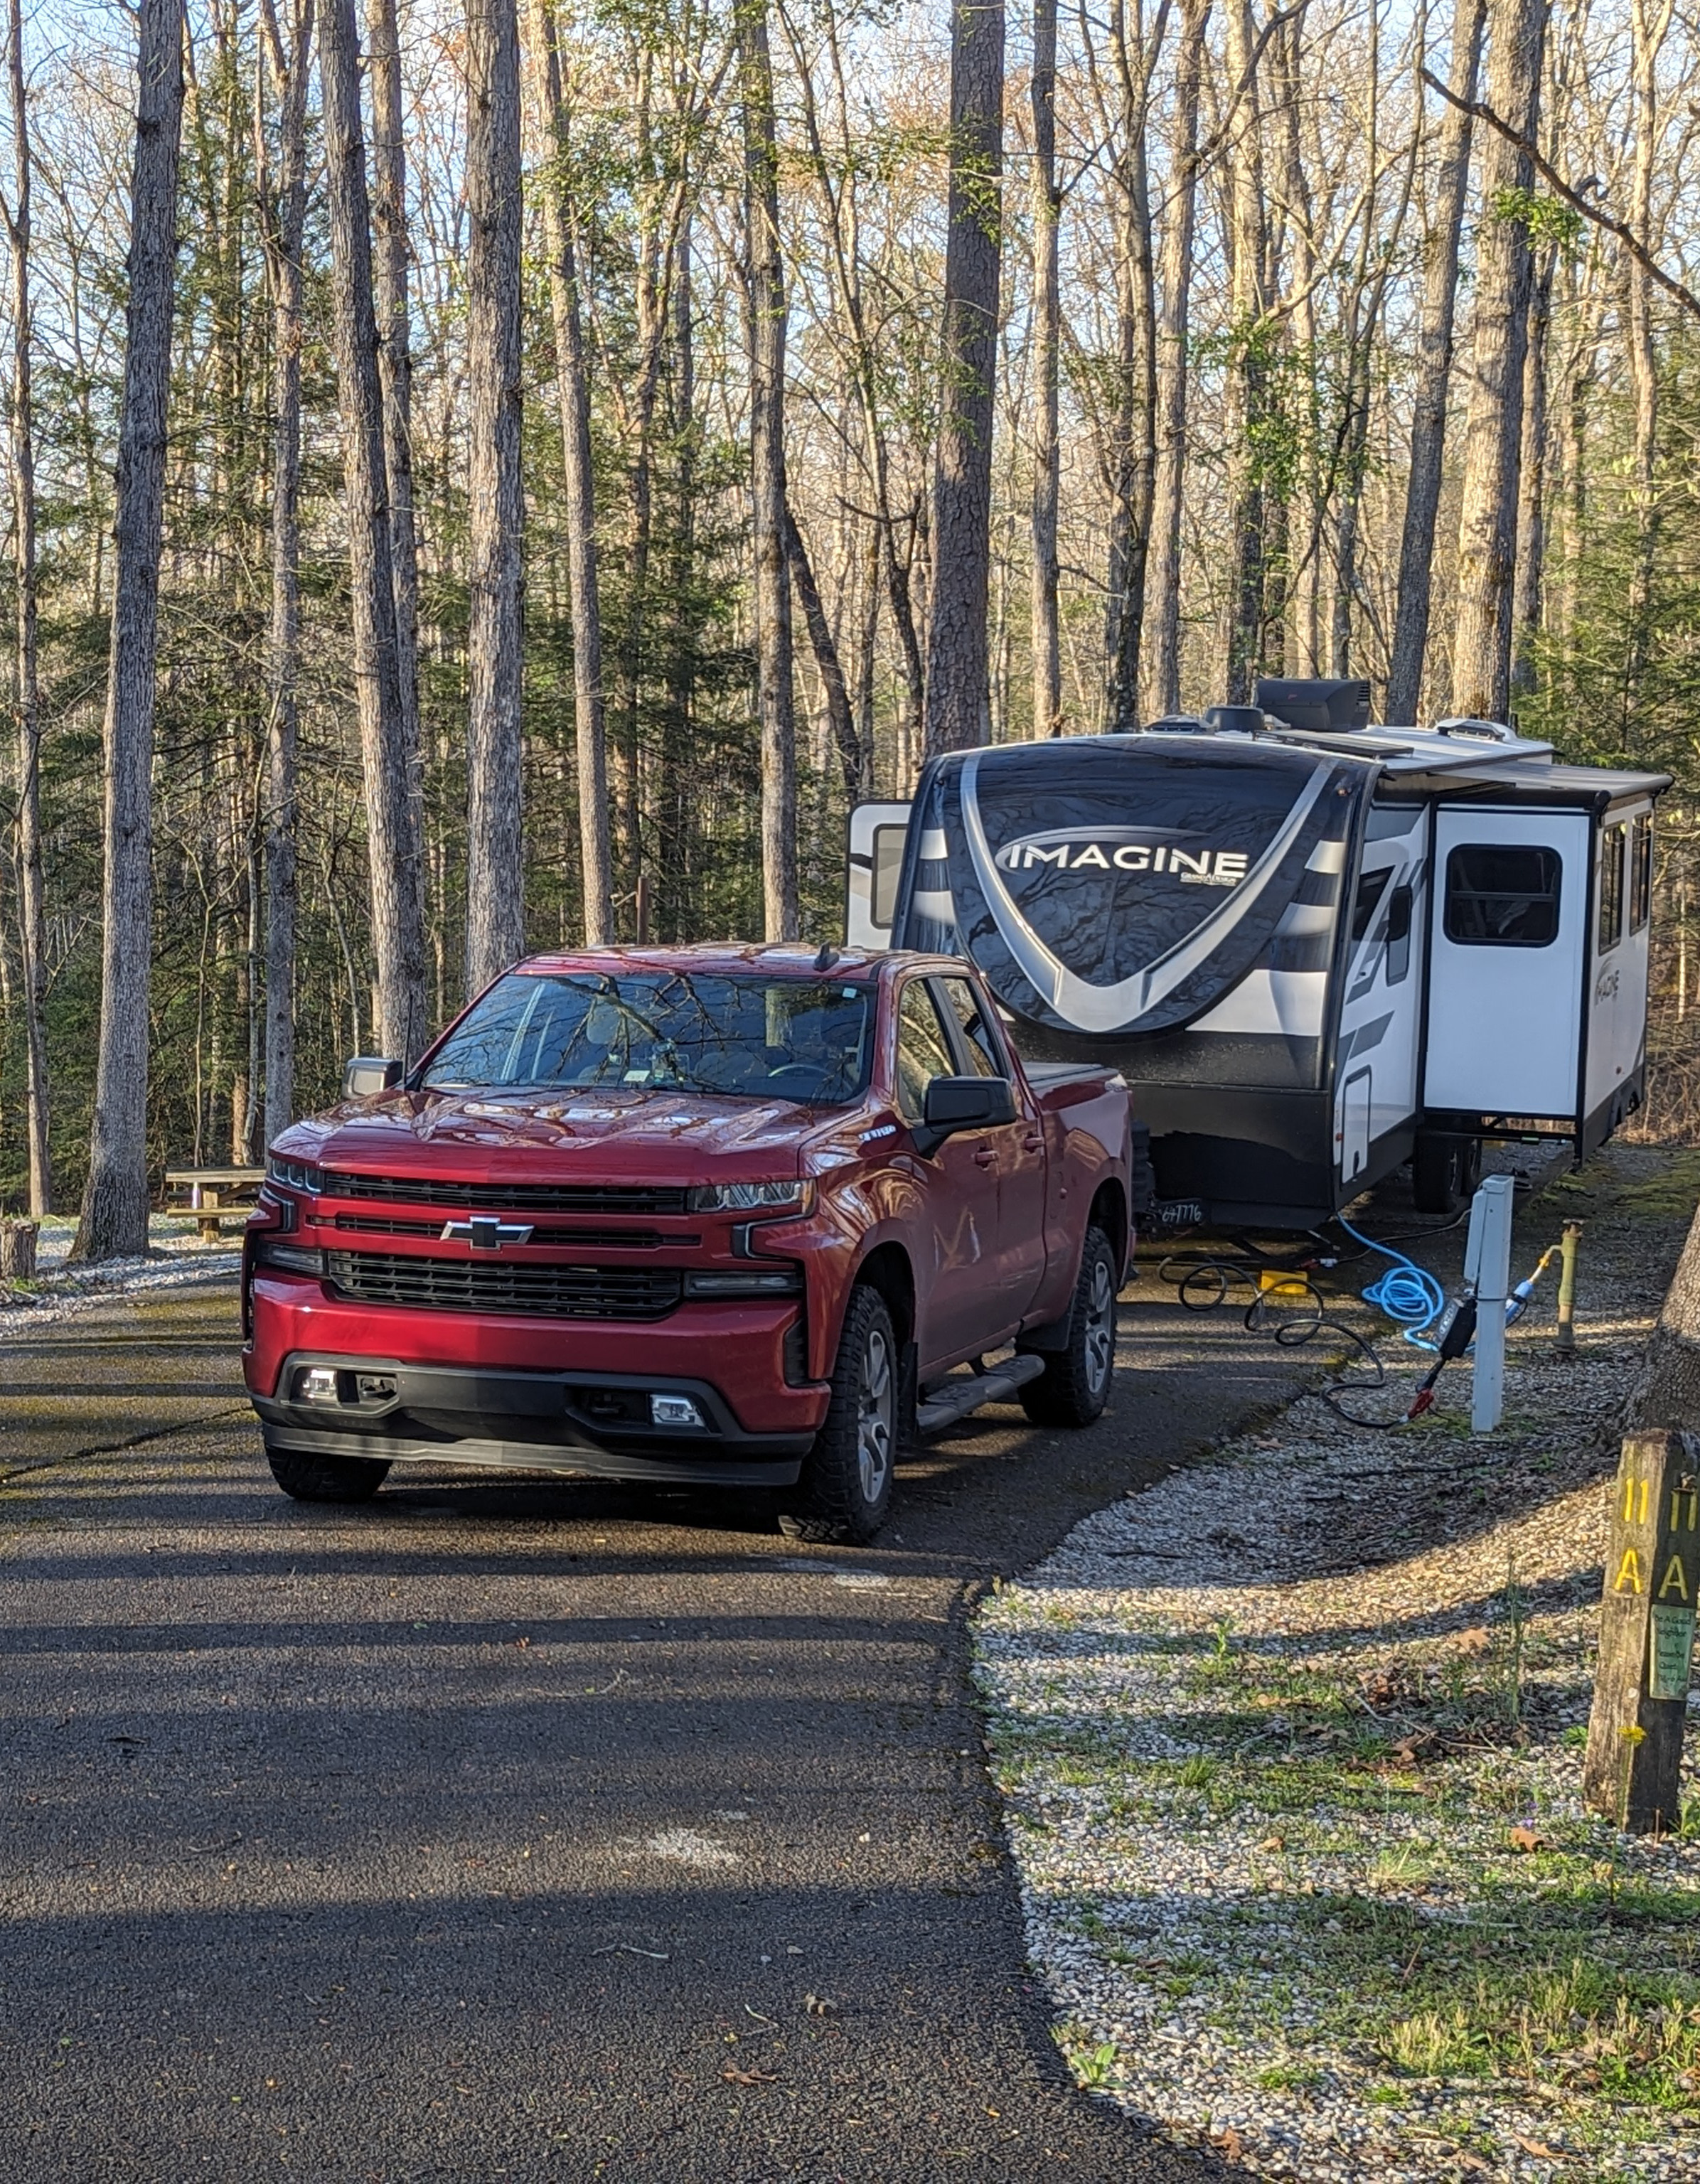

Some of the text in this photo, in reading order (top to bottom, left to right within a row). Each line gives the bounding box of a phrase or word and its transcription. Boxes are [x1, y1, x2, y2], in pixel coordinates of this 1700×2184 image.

[1009, 844, 1248, 877] IMAGINE
[1625, 1478, 1649, 1525] 11
[1614, 1548, 1641, 1594] A
[1658, 1555, 1688, 1600] A
